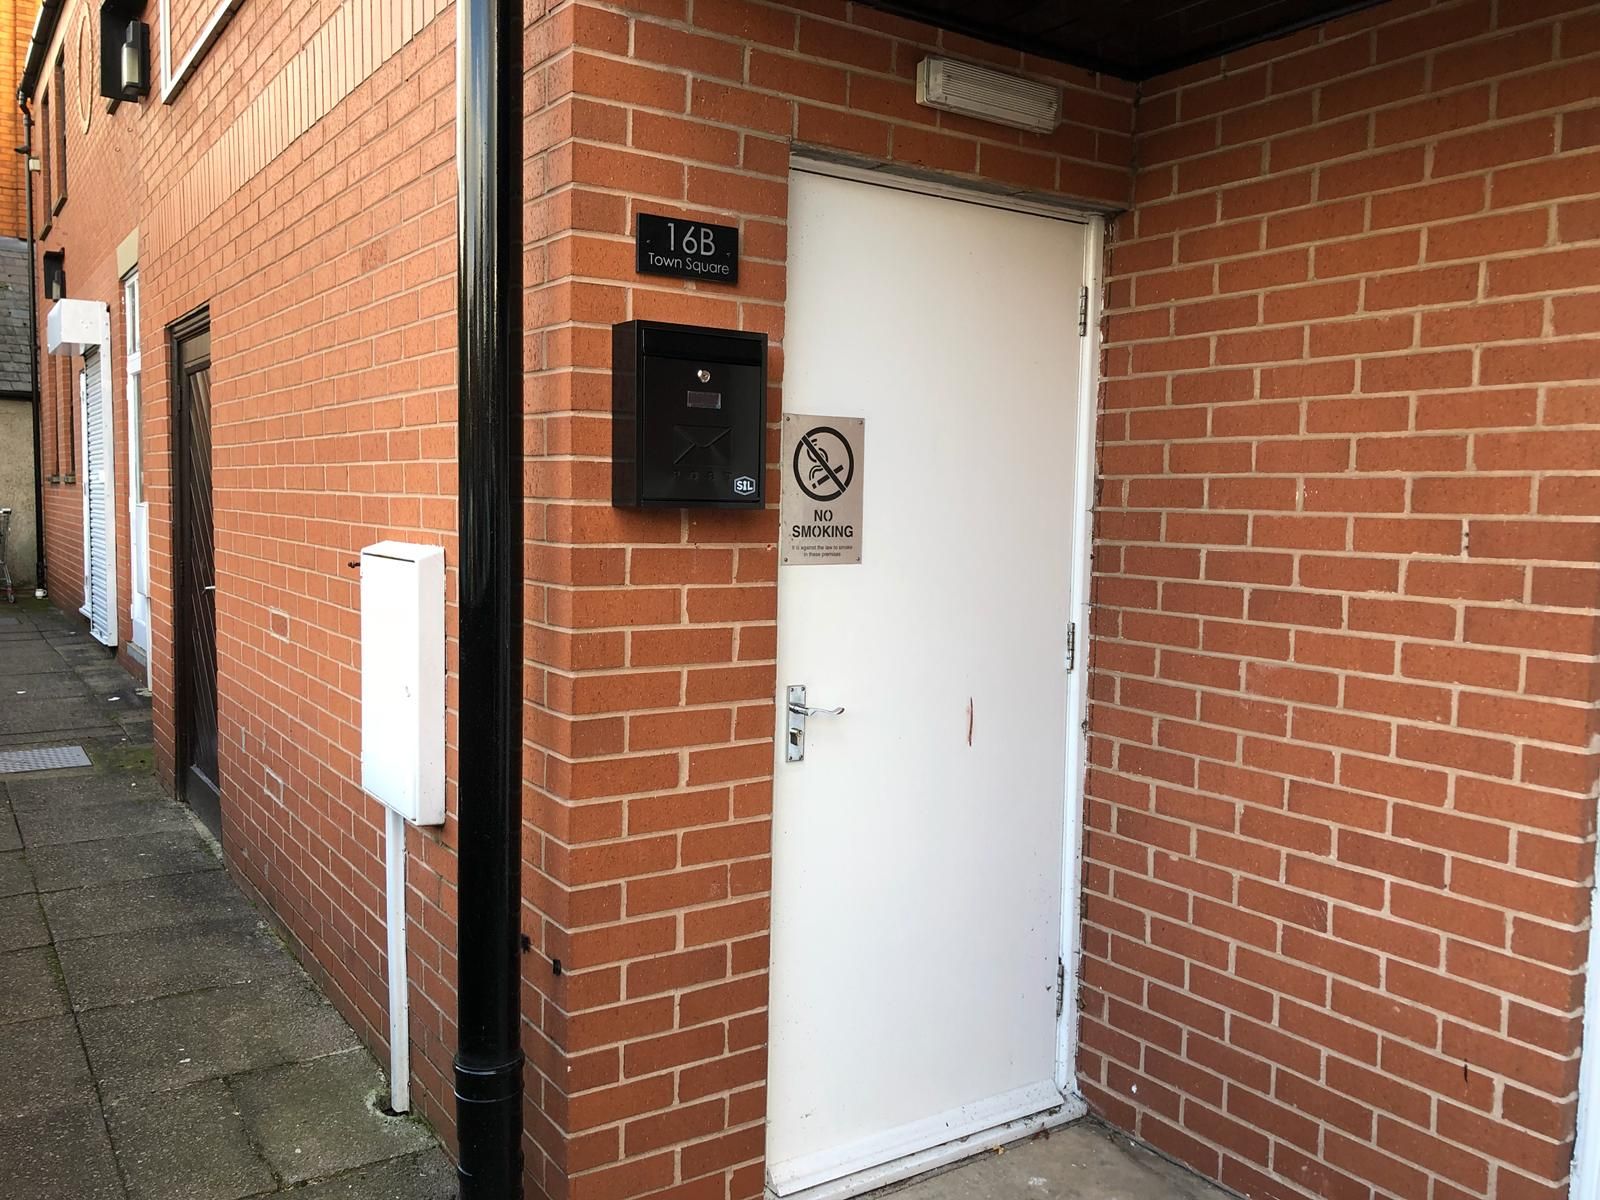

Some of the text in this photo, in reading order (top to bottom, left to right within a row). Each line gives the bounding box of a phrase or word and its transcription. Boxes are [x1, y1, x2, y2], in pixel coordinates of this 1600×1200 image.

[667, 223, 715, 256] 16B
[648, 252, 729, 275] Town Square
[814, 509, 833, 522] NO
[792, 525, 854, 538] SMOKING
